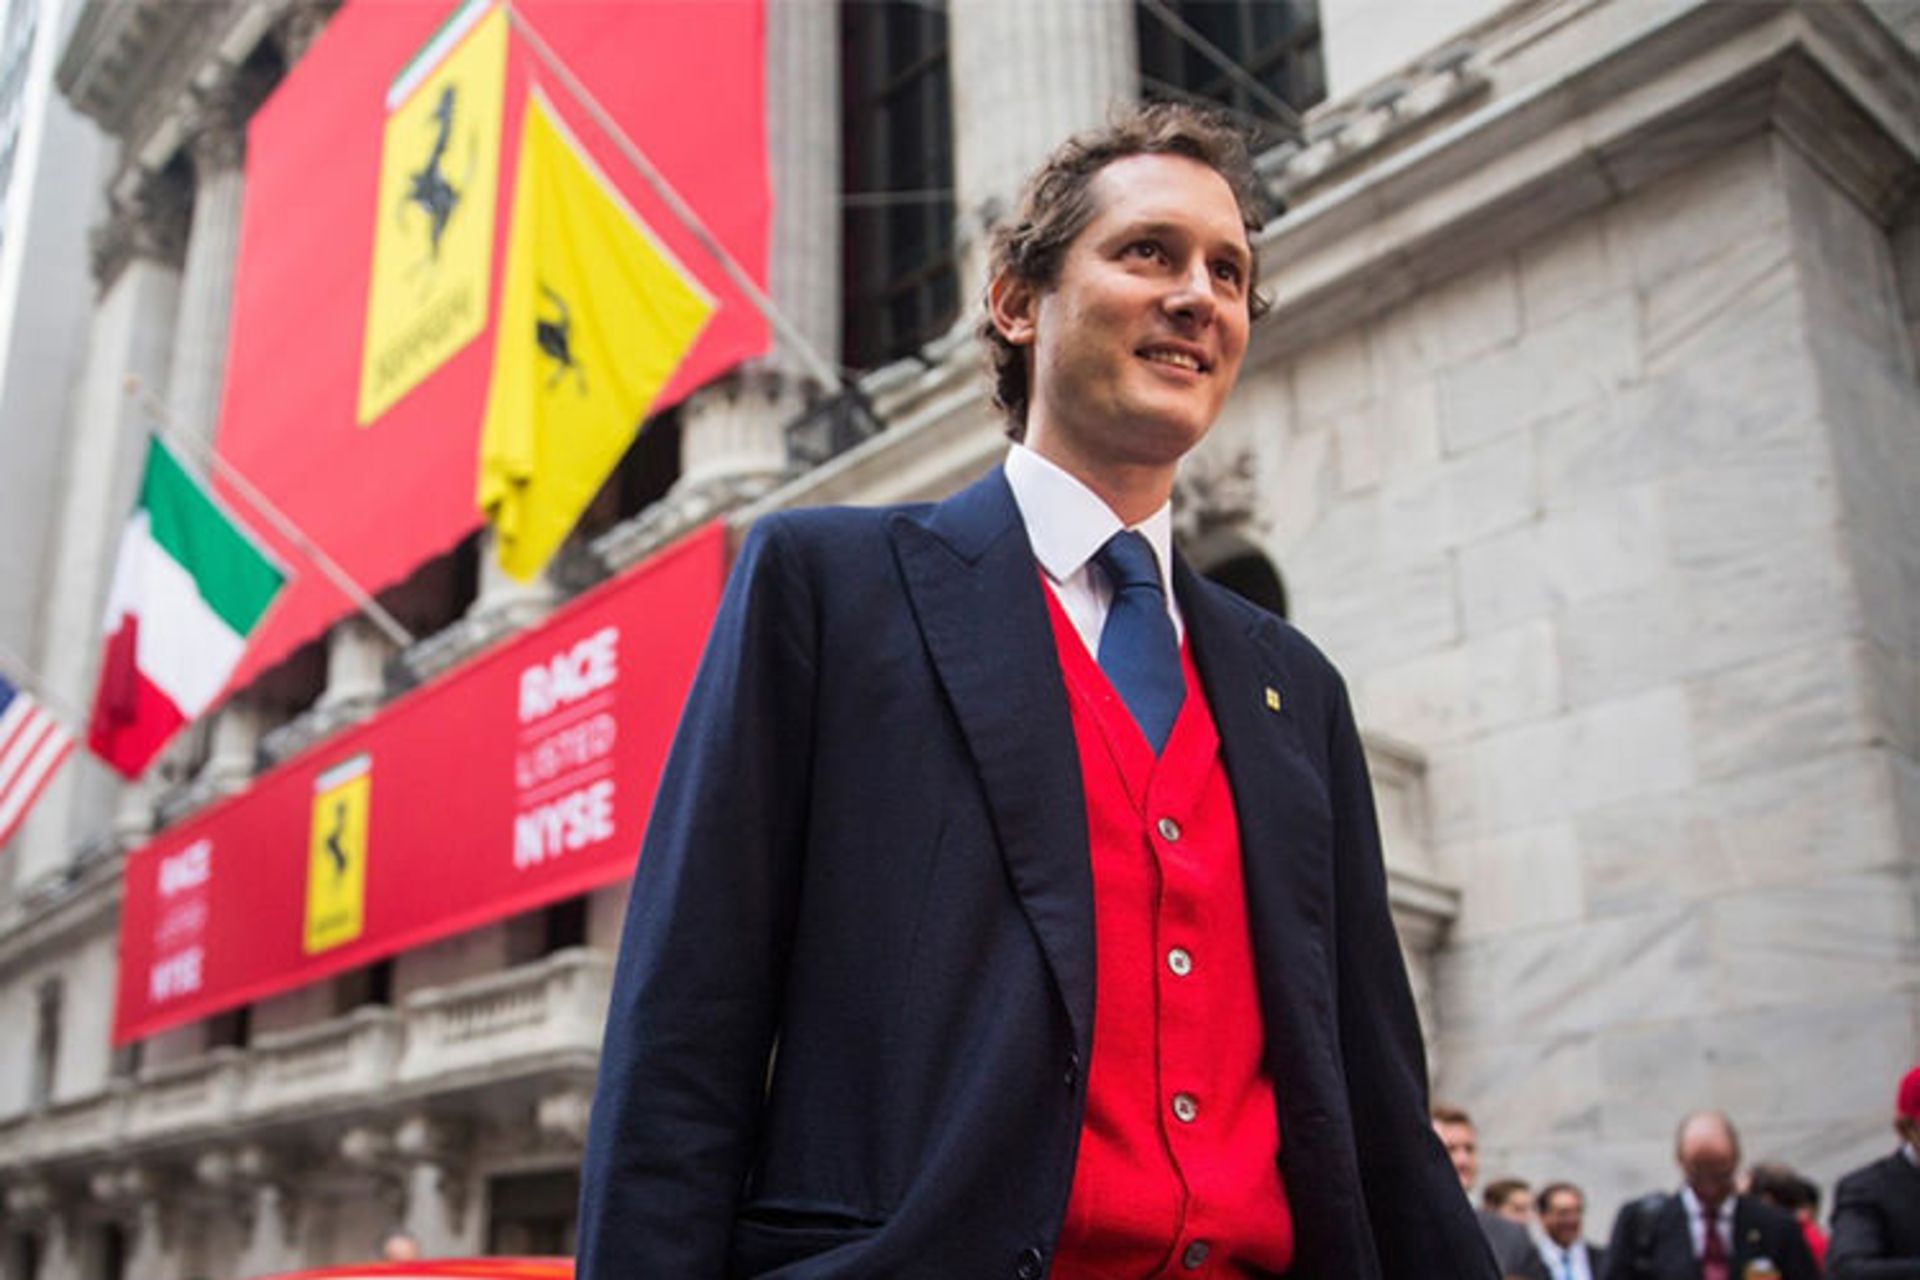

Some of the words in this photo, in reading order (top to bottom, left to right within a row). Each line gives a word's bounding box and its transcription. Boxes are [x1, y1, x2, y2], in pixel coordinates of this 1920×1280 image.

[518, 626, 620, 723] RACE
[515, 712, 616, 789] LISTED
[513, 779, 616, 870] NYSE
